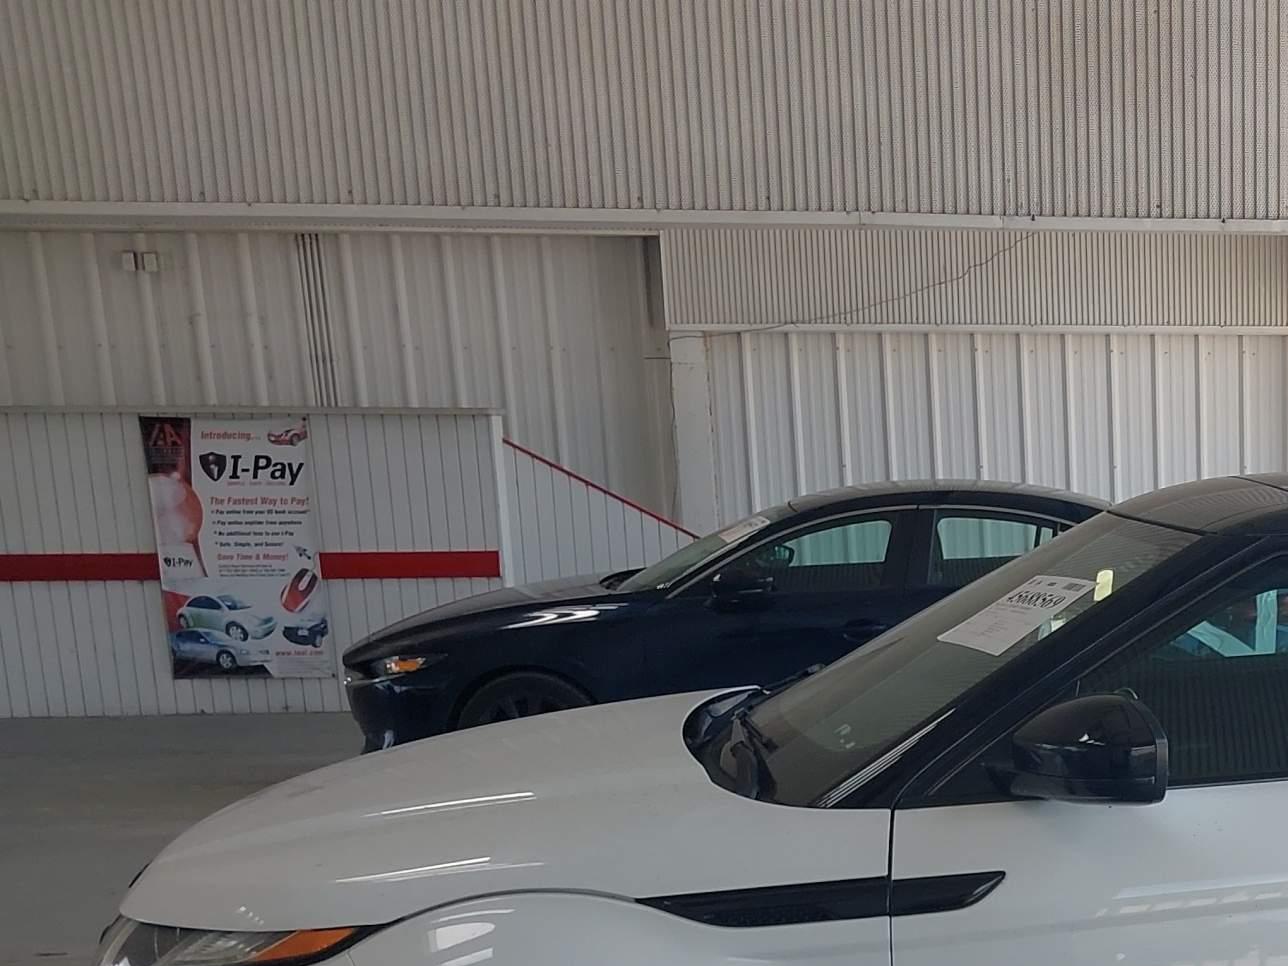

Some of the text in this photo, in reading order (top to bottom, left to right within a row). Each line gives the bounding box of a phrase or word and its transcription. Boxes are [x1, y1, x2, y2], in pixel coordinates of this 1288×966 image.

[229, 455, 304, 486] I-Pay
[210, 496, 309, 507] The Fastest Way to Pay!
